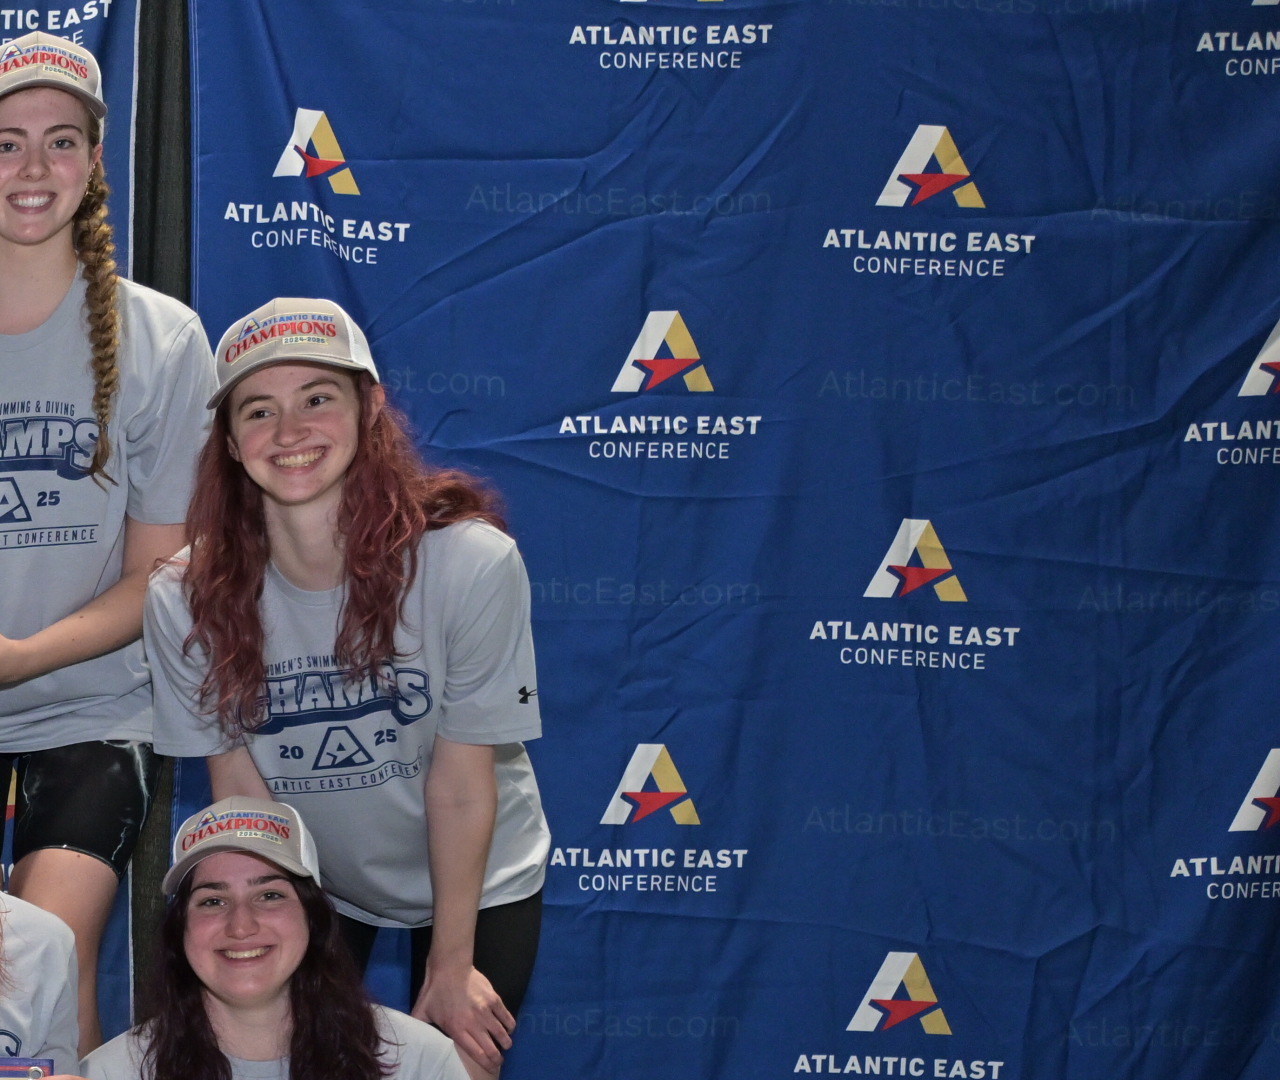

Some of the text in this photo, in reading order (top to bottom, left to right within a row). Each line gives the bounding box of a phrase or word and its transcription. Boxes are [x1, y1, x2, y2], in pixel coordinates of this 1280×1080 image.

[46, 0, 113, 30] EAST
[569, 24, 772, 45] ATLANTIC EAST
[1197, 31, 1280, 51] ATLAN
[600, 51, 741, 68] CONFERENCE
[224, 201, 410, 242] ATLANTIC EAST
[252, 225, 377, 264] CONFERENCE
[823, 229, 1035, 253] ATLANTIC EAST
[854, 256, 1005, 276] CONFERENCE
[225, 321, 336, 363] CHAMPIONS
[34, 400, 41, 412] &
[44, 400, 75, 417] DIVING
[559, 416, 761, 435] ATLANTIC EAST
[1184, 421, 1280, 442] ATLANT
[589, 441, 729, 459] CONFERENCE
[36, 490, 60, 507] 25
[17, 528, 95, 545] CONFERENCE
[810, 621, 1020, 646] ATLANTIC EAST
[840, 648, 985, 669] CONFERENCE
[279, 729, 396, 760] 20 25
[182, 817, 289, 851] CHAMPIONS
[551, 848, 748, 868] ATLANTIC EAST
[1170, 856, 1280, 877] ATLANTI
[579, 875, 716, 892] CONFERENCE
[794, 1055, 1004, 1079] ATLANTIC EAST
